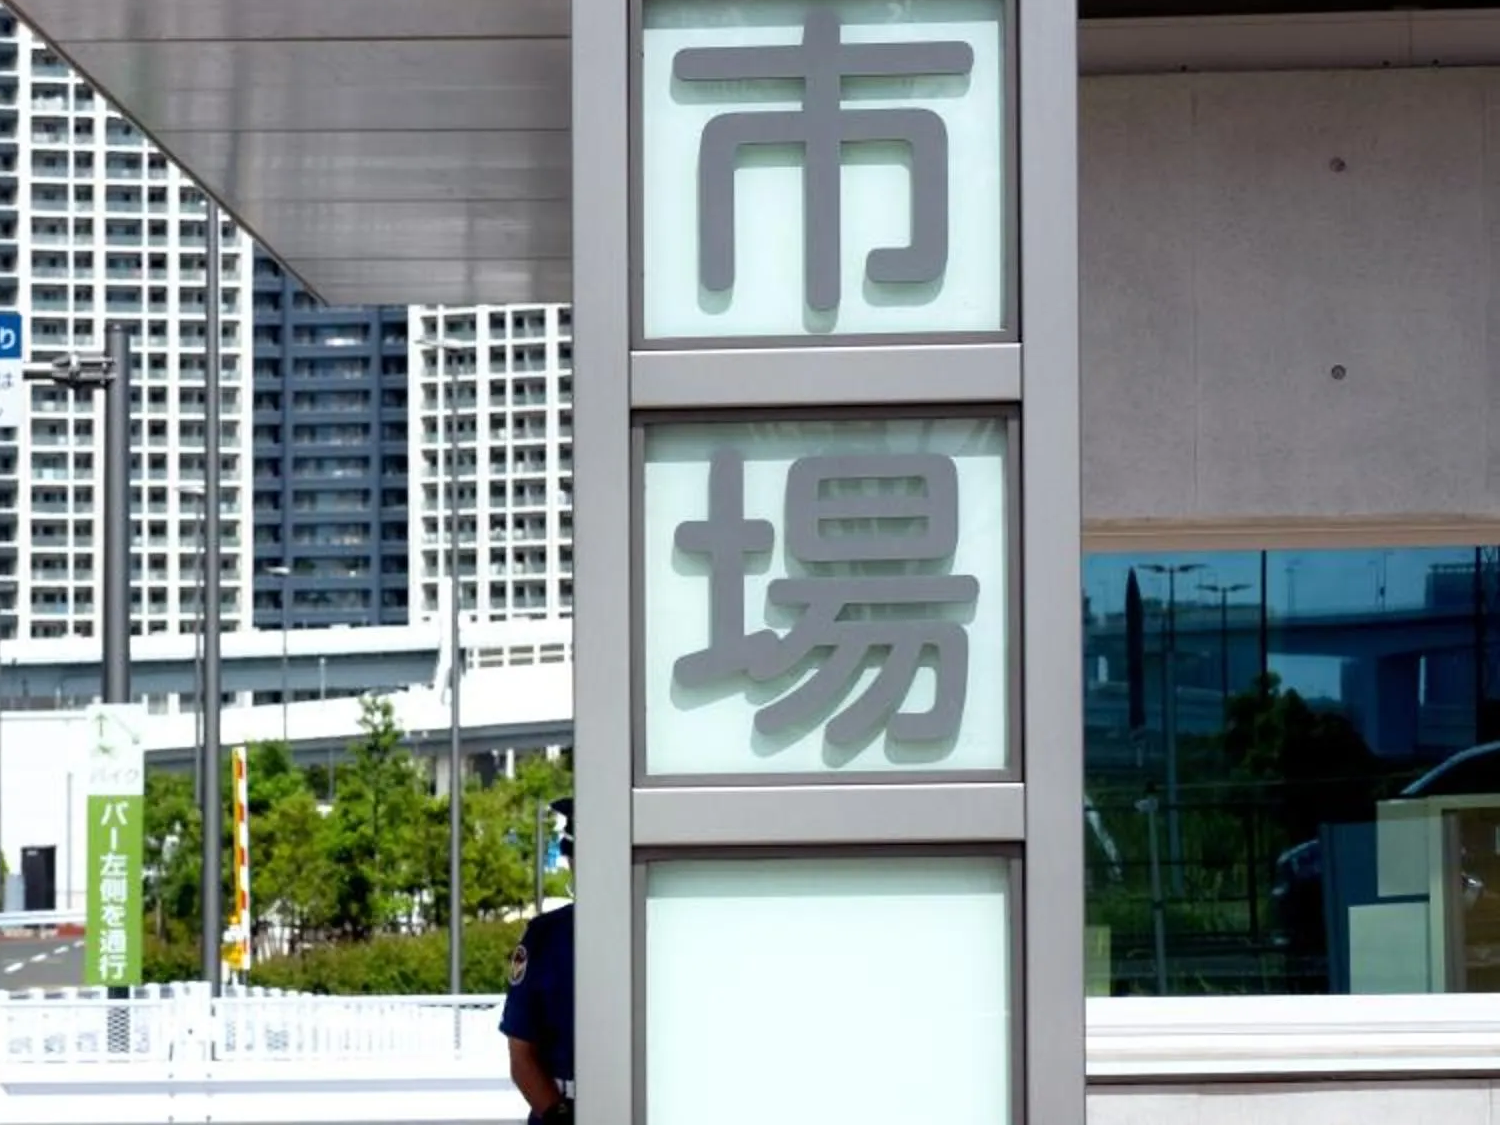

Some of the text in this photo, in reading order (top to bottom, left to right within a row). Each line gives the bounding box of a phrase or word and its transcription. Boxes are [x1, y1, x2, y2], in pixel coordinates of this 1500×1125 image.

[98, 800, 129, 980] バー左側を通行
